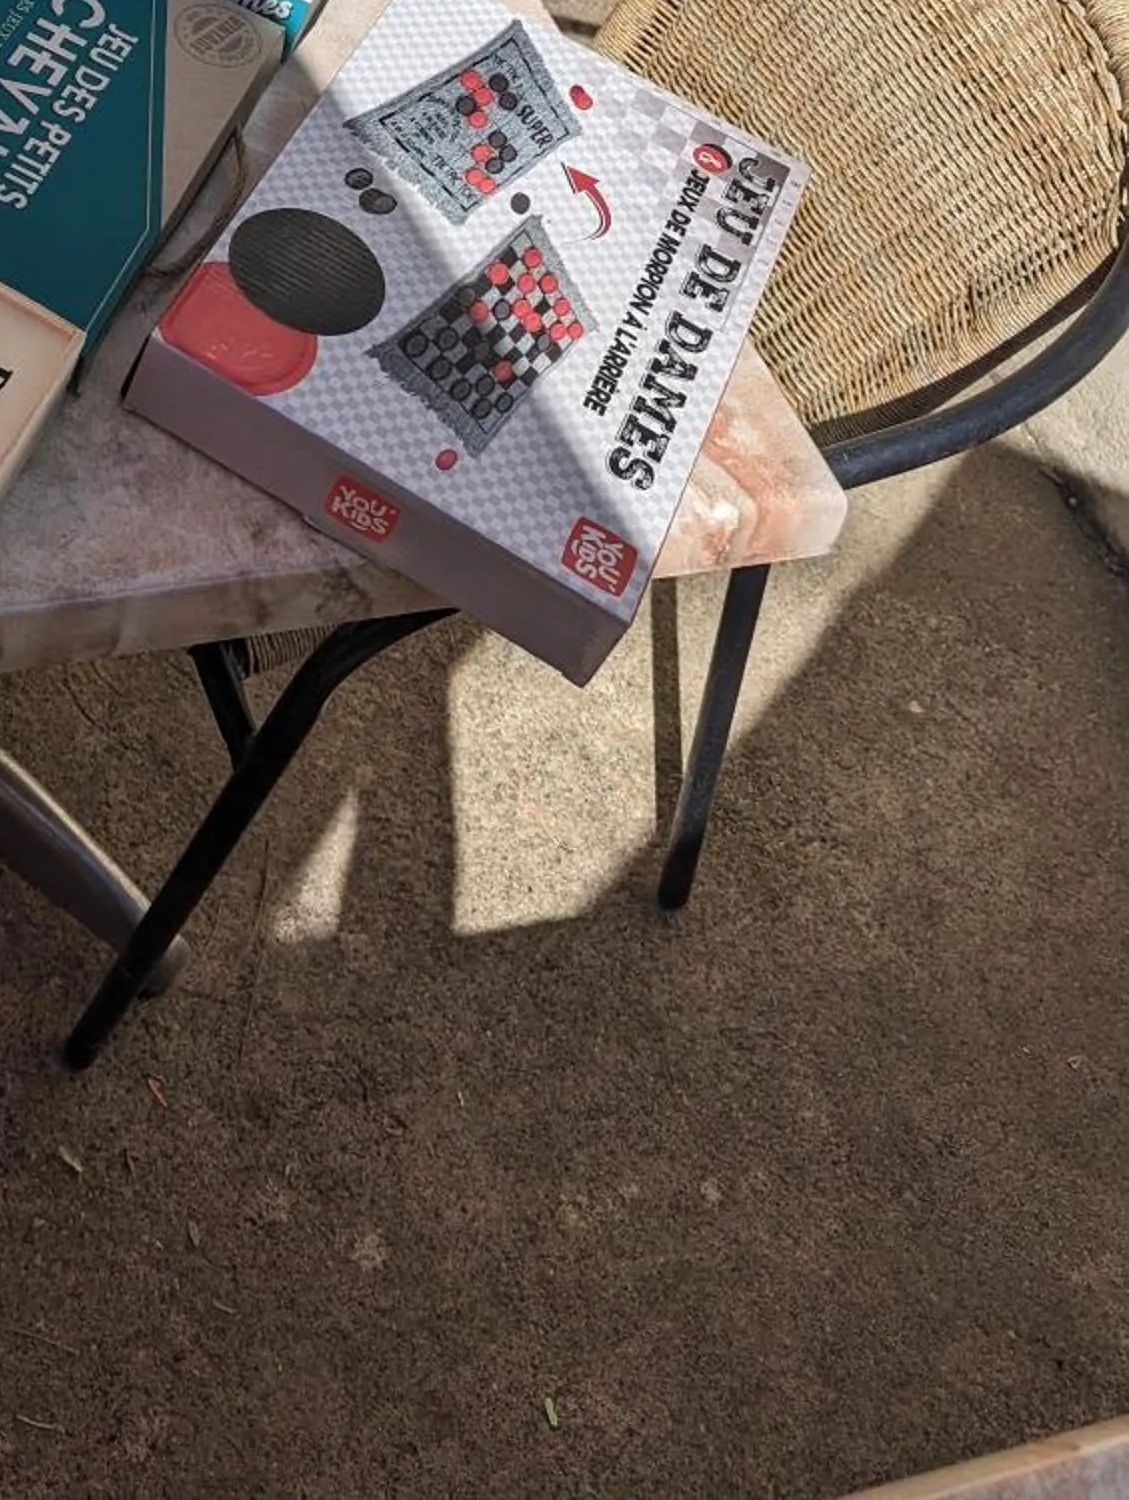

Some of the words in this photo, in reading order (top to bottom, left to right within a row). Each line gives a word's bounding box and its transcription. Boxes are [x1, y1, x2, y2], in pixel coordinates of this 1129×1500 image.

[89, 23, 139, 79] JEU
[52, 66, 111, 124] DES
[516, 103, 553, 152] SUPER
[678, 168, 711, 213] JEUX
[714, 156, 777, 247] JEU
[665, 208, 692, 238] DE
[629, 231, 682, 320] MORPION
[680, 243, 743, 314] DE
[582, 332, 632, 419] L'ARRIÈRE
[603, 310, 715, 492] DAMES
[331, 495, 389, 534] KIDS
[339, 483, 389, 518] YOU
[572, 525, 603, 581] KIDS
[595, 535, 626, 586] YOU
